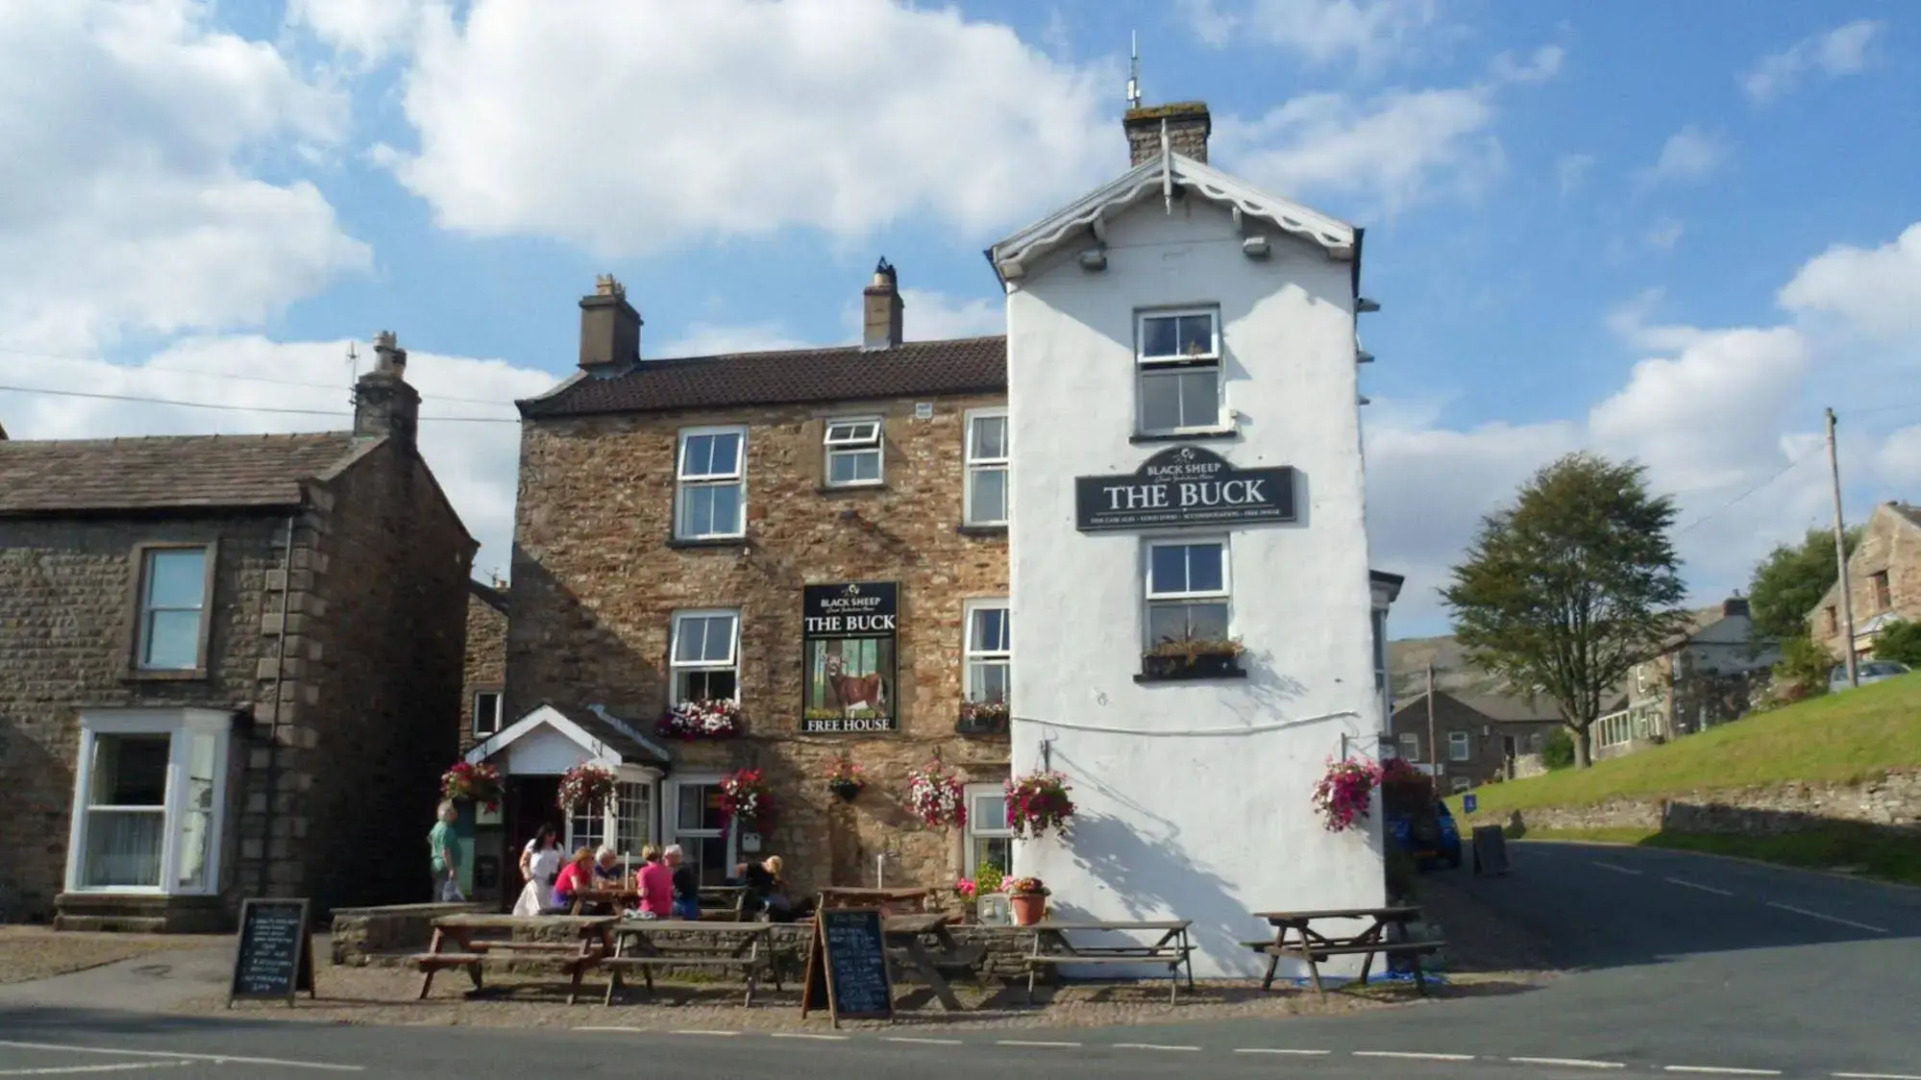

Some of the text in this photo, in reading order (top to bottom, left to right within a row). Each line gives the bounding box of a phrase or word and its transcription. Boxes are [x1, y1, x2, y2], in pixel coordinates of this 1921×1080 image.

[1147, 463, 1222, 476] BLACK SHEEP
[1103, 480, 1266, 510] THE BUCK
[820, 597, 881, 608] BLACK SHEEP
[805, 614, 896, 632] THE BUCK
[807, 718, 890, 731] FREE HOUSE
